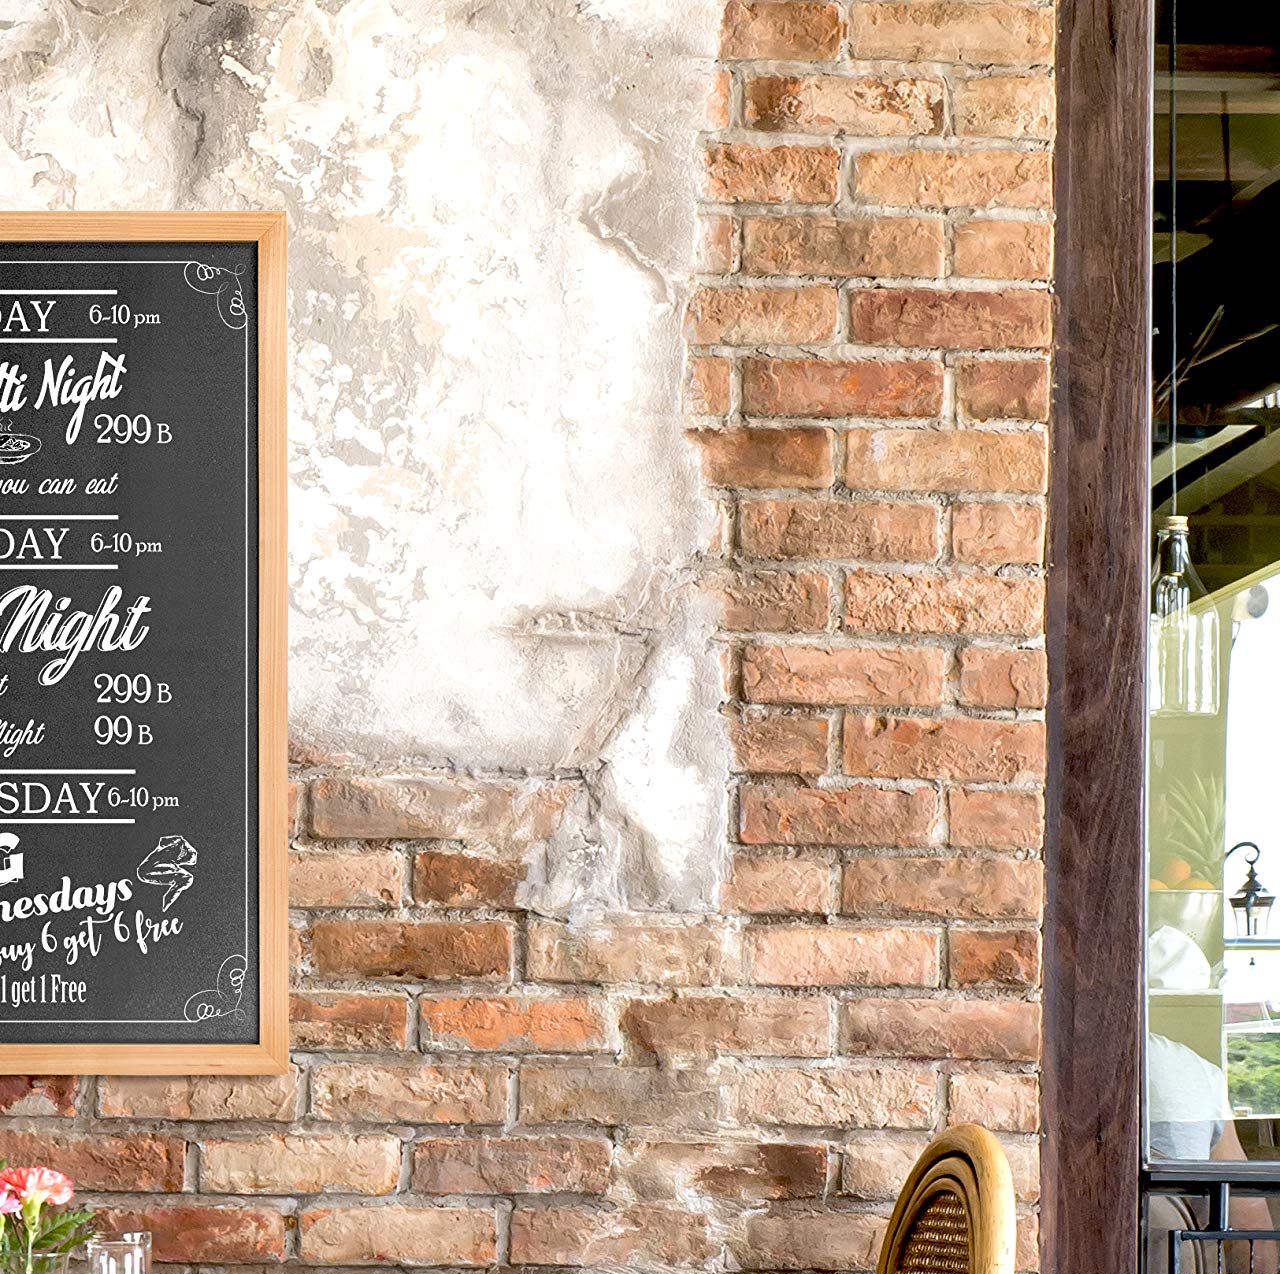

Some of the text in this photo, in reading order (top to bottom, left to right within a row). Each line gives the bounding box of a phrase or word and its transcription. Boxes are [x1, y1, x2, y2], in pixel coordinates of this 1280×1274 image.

[133, 313, 161, 329] pm
[32, 350, 128, 446] Night
[93, 413, 173, 445] 299 B
[38, 478, 77, 495] can
[84, 472, 119, 495] eat
[134, 541, 163, 557] pm
[93, 673, 152, 704] 299
[156, 682, 173, 704] B
[93, 715, 133, 746] 99
[137, 724, 154, 745] B
[151, 796, 180, 812] pm
[41, 920, 58, 953] 6
[63, 912, 115, 966] get
[113, 910, 130, 943] 6
[135, 909, 184, 955] free
[0, 974, 7, 1003] 1
[11, 976, 37, 1008] get
[39, 974, 47, 1004] 1
[50, 973, 87, 1004] Free
